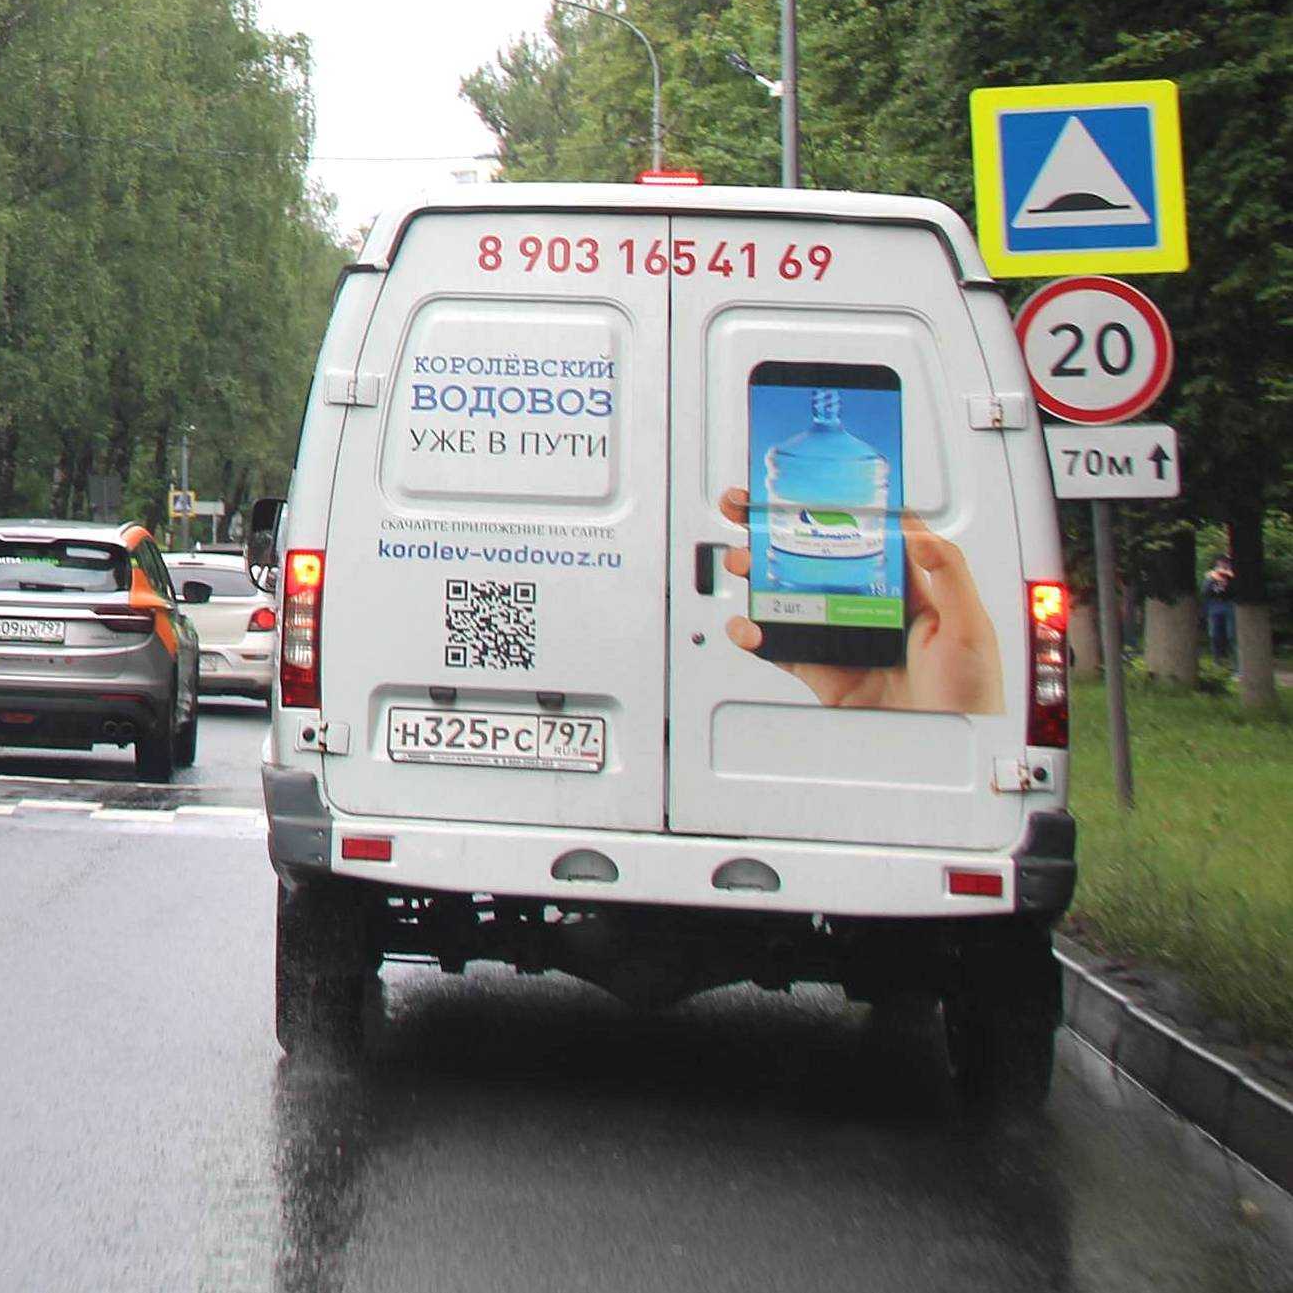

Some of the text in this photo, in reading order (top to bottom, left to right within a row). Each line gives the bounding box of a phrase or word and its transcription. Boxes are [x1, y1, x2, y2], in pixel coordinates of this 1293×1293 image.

[478, 235, 503, 271] 8
[518, 236, 600, 274] 903
[707, 241, 757, 279] 41
[778, 243, 833, 281] 69
[1049, 322, 1134, 376] 20
[413, 354, 615, 379] КОРОЛЁВСКИЙ
[411, 383, 613, 418] ВОДОВОЗ
[410, 428, 608, 457] УЖЕ В ПУТИ
[380, 515, 449, 533] СКАЧАЙТЕ
[451, 519, 545, 537] ПРИЛОЖЕНИЕ
[548, 524, 568, 537] НА
[378, 539, 623, 568] korolev-vodovoz.ru
[401, 716, 593, 752] Н325РС 797
